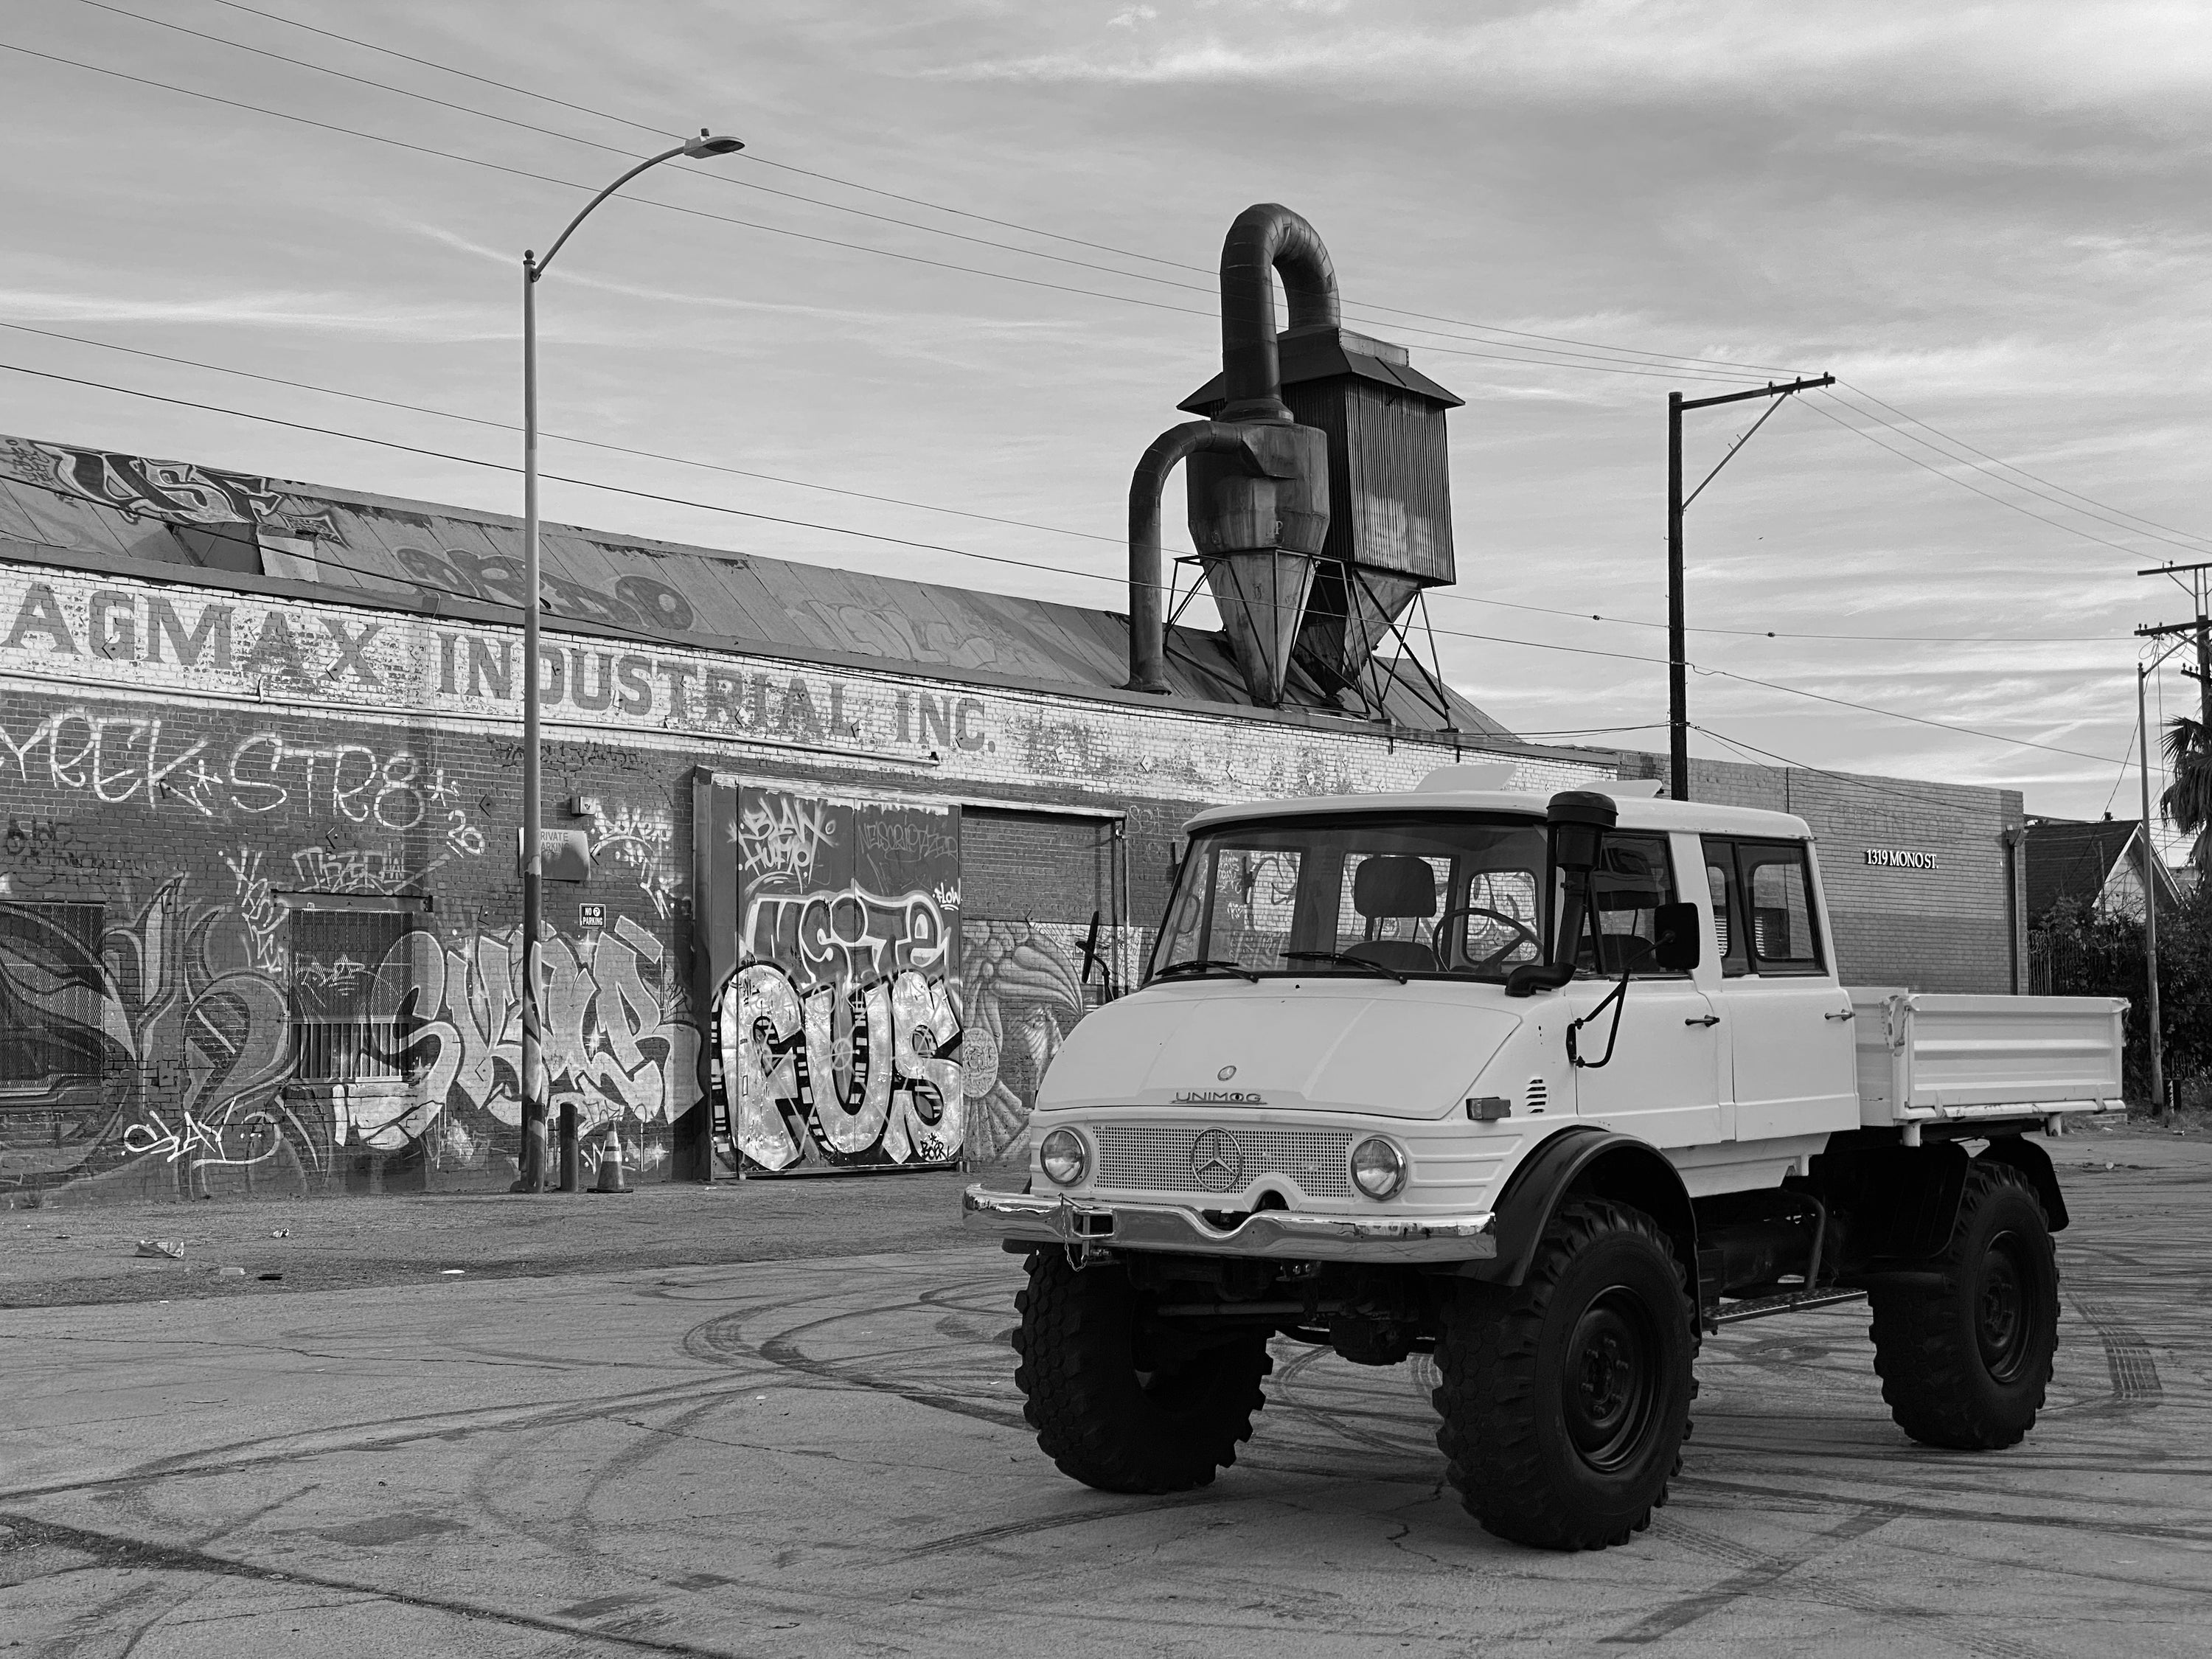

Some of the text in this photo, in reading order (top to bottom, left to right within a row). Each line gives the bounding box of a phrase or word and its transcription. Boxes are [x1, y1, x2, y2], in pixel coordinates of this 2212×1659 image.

[1, 581, 386, 687] AGMAX
[437, 632, 860, 740] INDUSTRIAL
[894, 689, 996, 752] INC.
[541, 831, 568, 842] RIVATE
[541, 842, 570, 852] ARKIN
[1866, 849, 1939, 869] 1319 MONO ST.
[585, 907, 592, 916] NO
[582, 917, 603, 925] PARKING
[1175, 1091, 1262, 1102] UNIMOG
